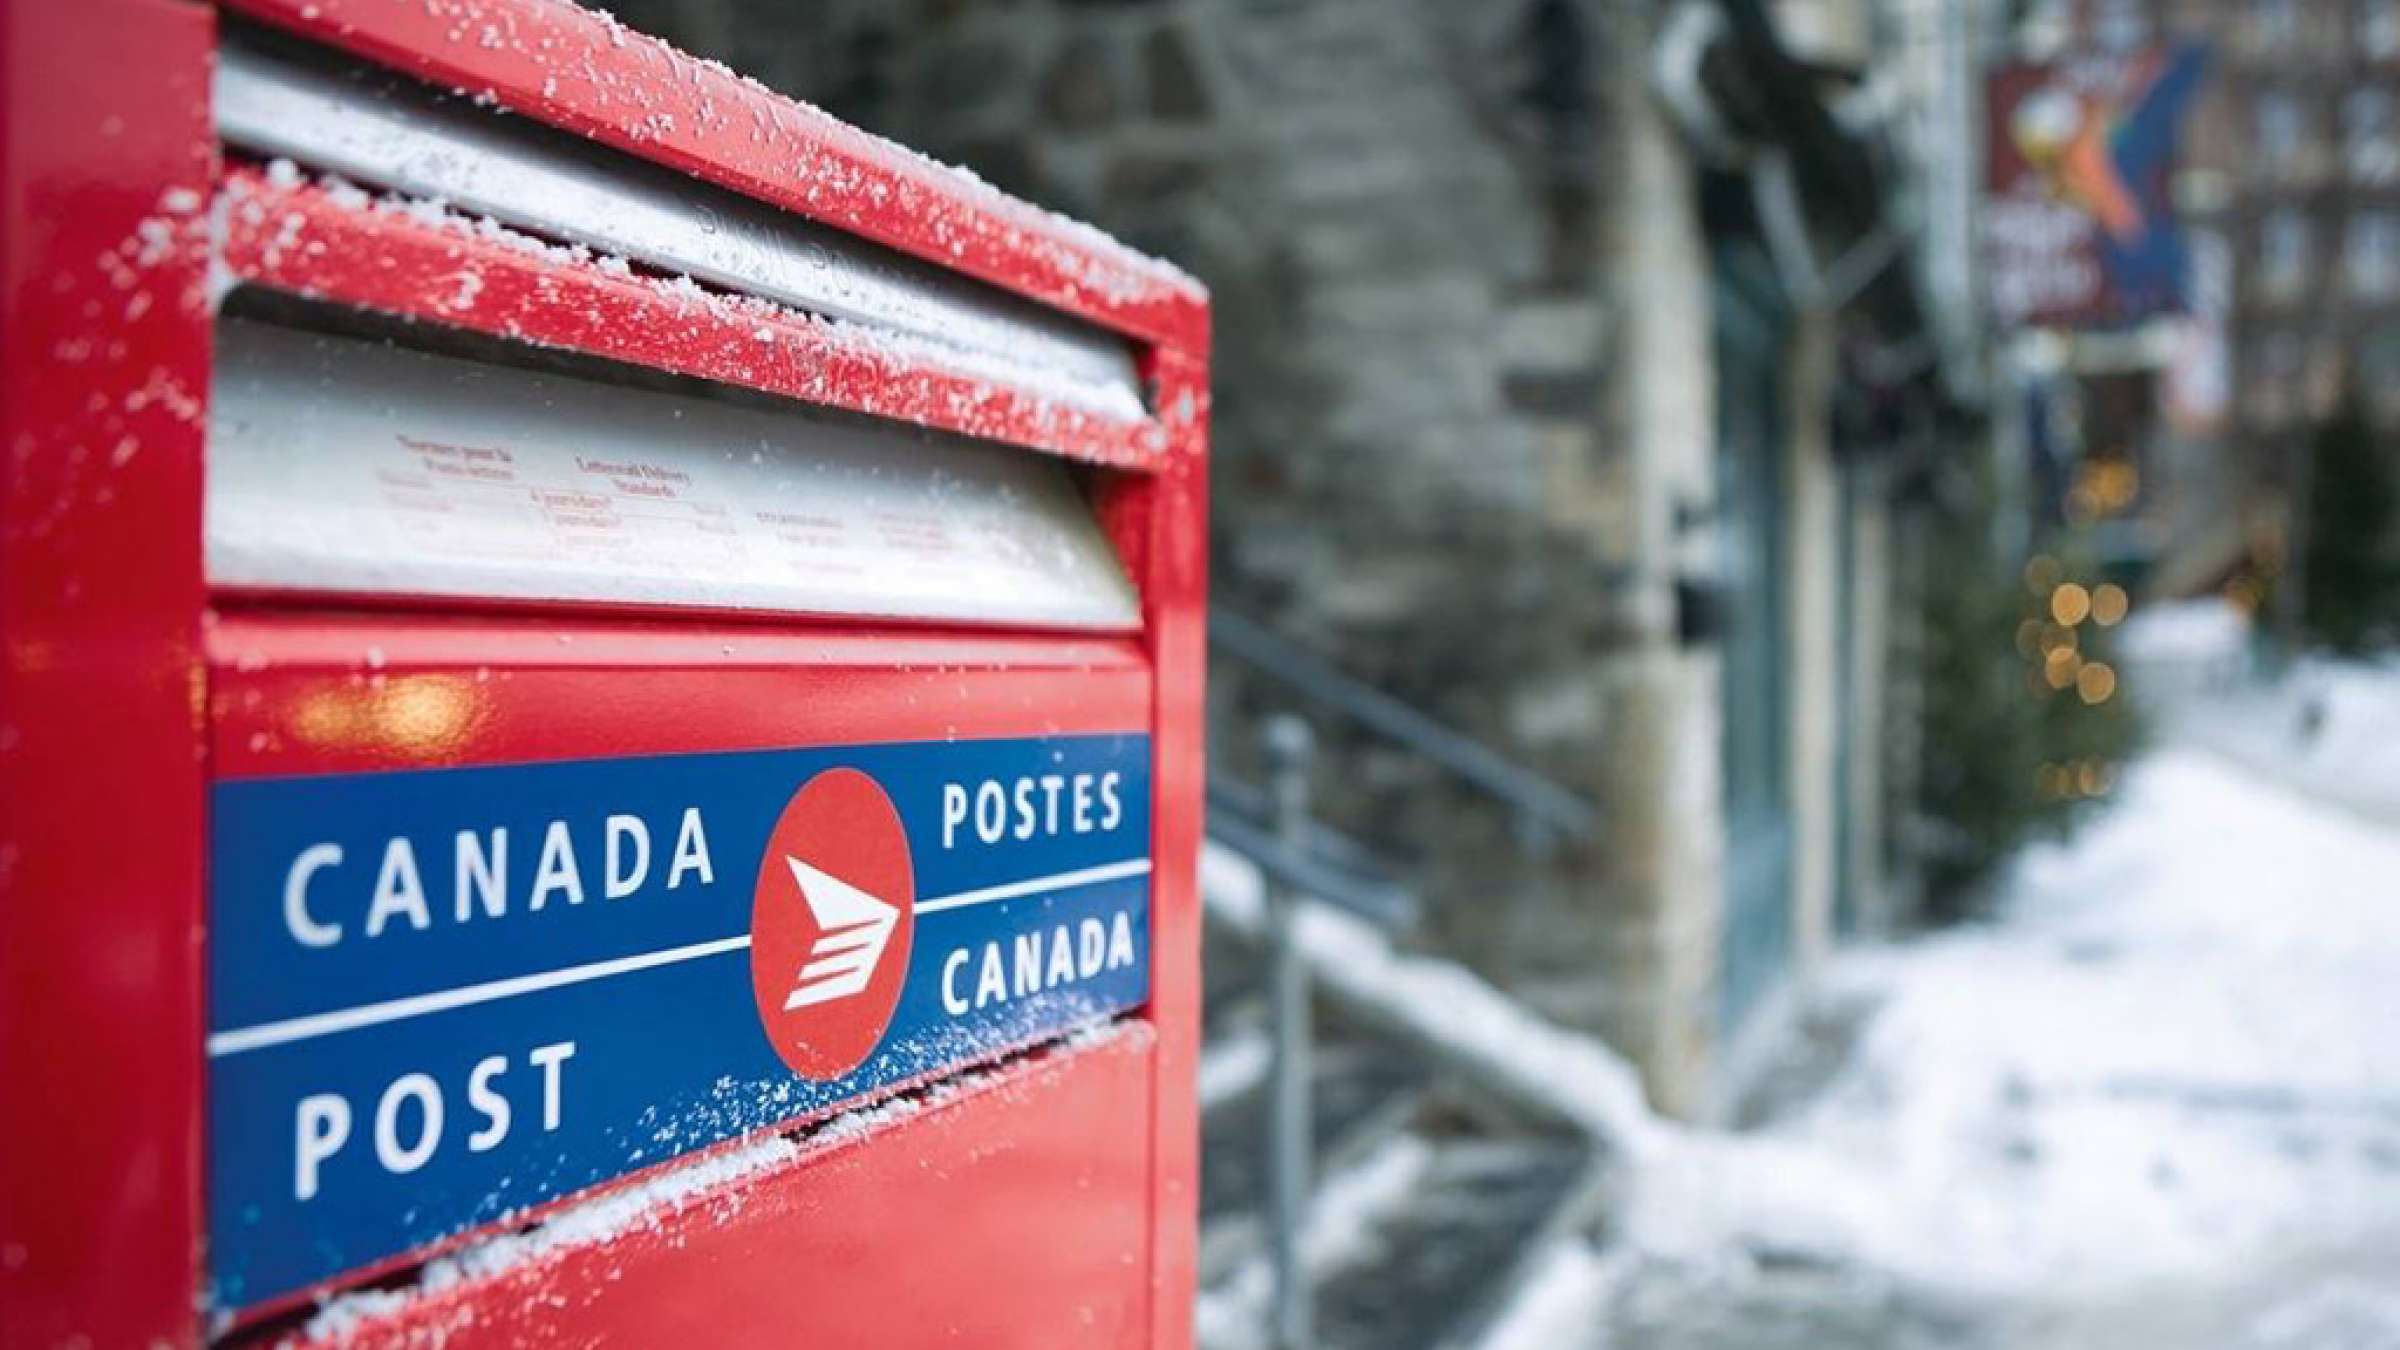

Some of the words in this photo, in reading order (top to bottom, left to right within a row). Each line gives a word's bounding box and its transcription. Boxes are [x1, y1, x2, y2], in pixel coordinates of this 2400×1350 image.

[943, 771, 1122, 849] POSTES
[284, 807, 715, 947] CANADA
[941, 911, 1135, 1016] CANADA
[293, 1042, 578, 1202] POST
